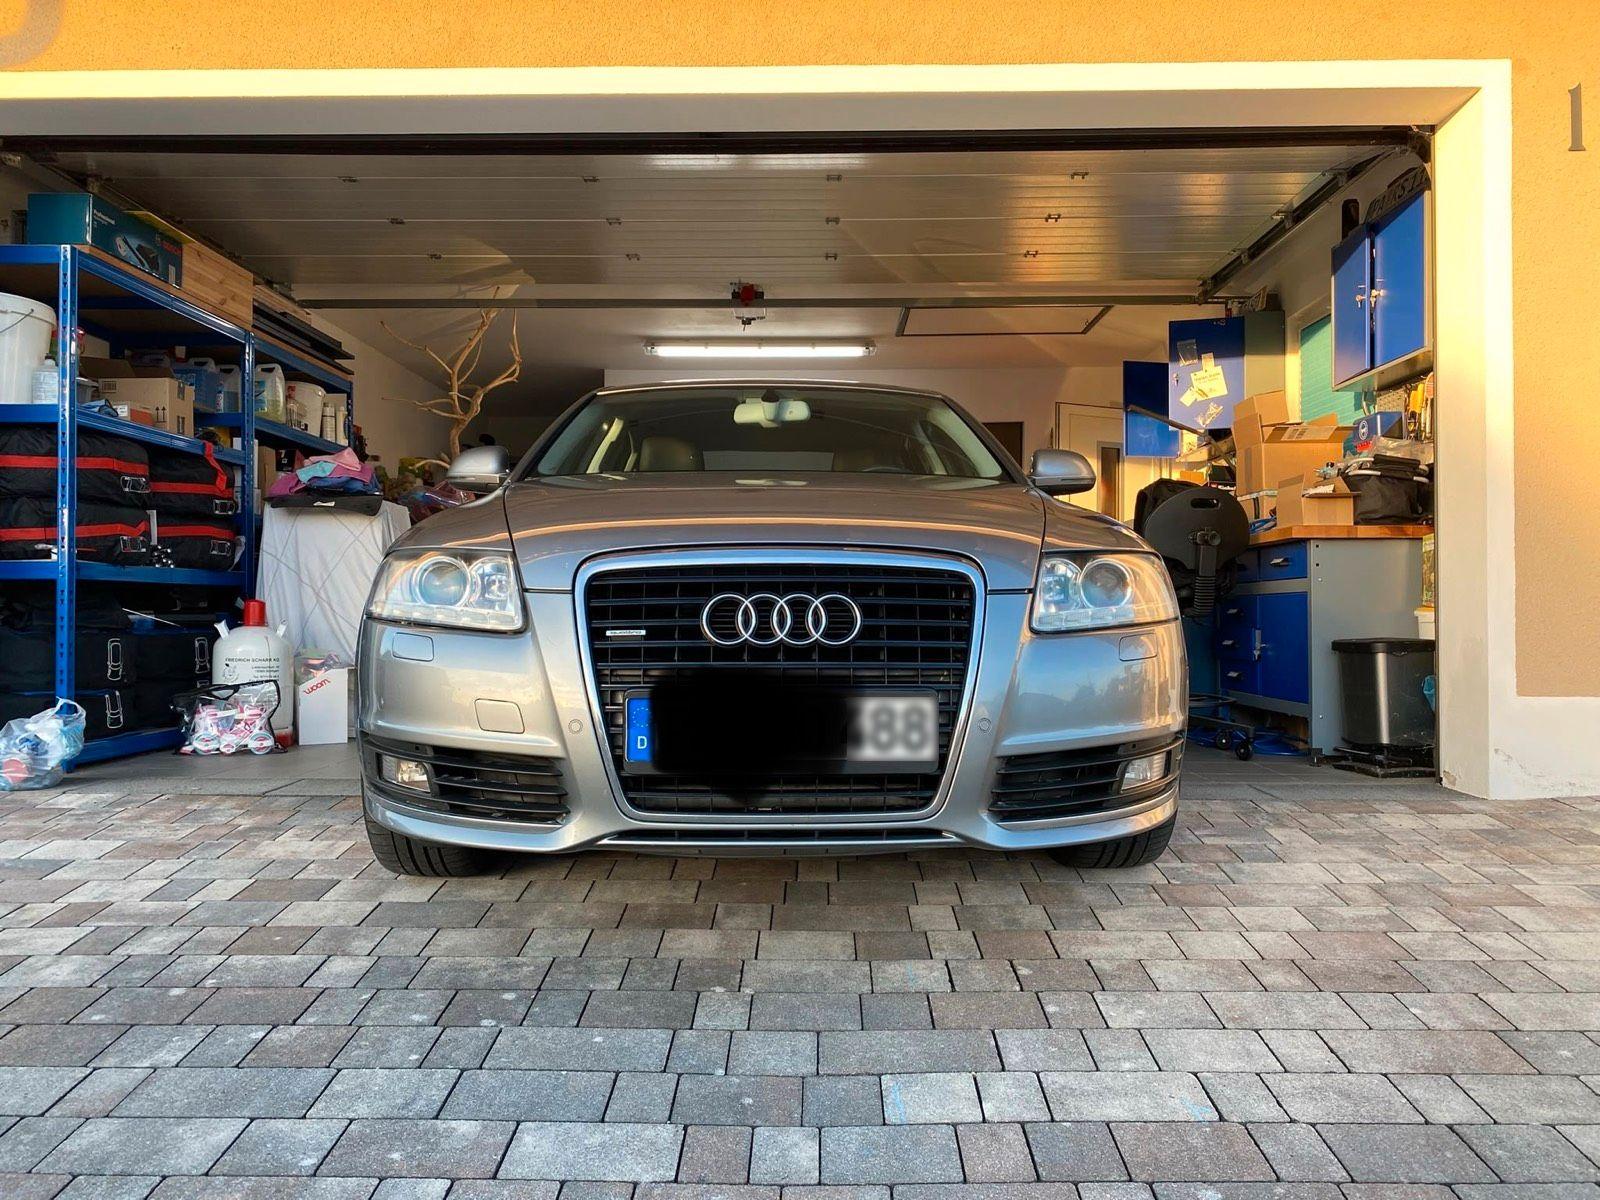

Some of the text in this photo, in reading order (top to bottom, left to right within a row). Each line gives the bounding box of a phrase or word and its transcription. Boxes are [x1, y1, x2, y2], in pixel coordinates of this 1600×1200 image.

[1568, 81, 1586, 152] 1
[304, 679, 331, 694] woom
[637, 735, 648, 749] D
